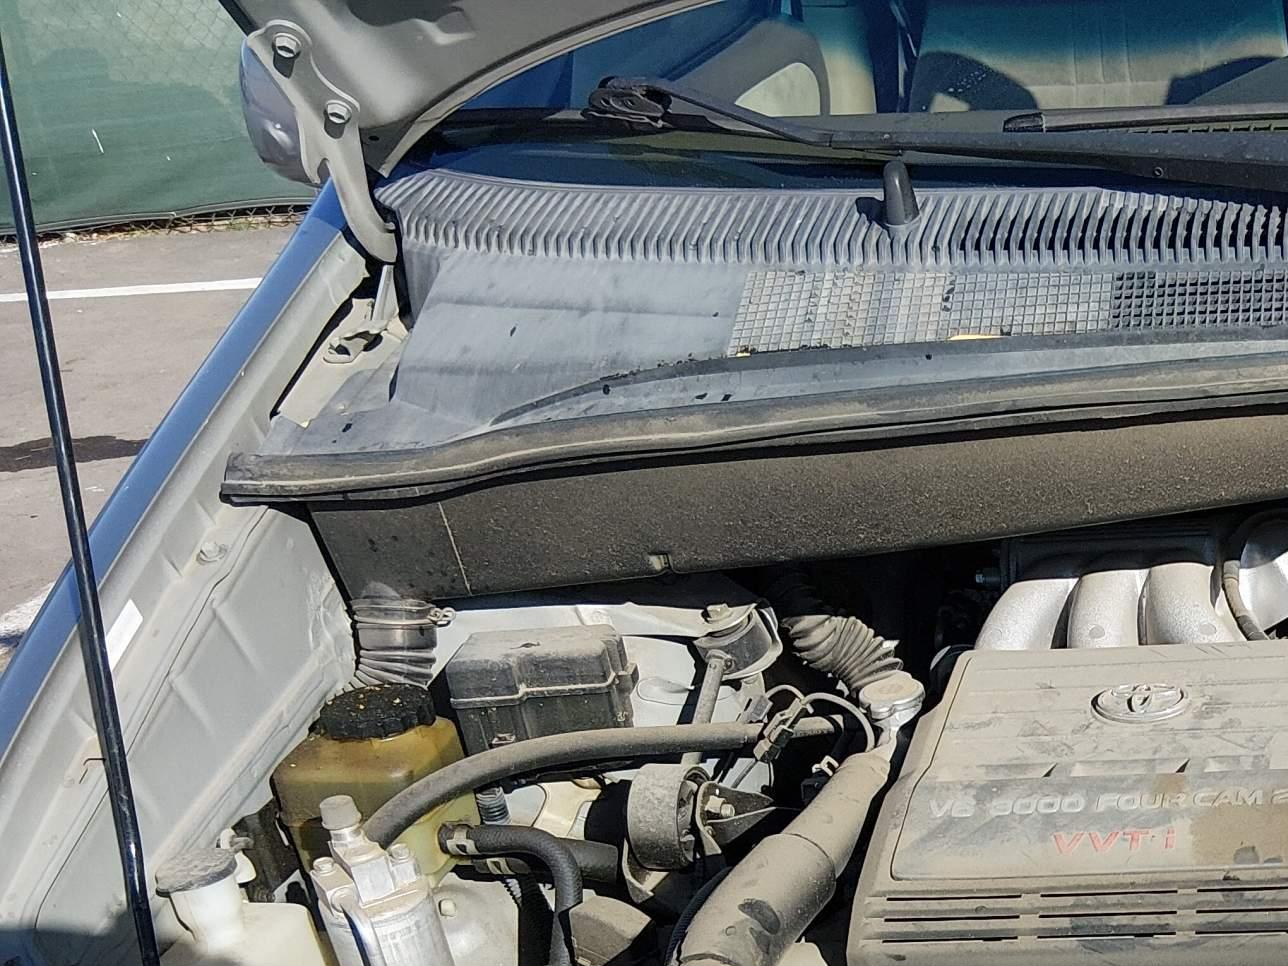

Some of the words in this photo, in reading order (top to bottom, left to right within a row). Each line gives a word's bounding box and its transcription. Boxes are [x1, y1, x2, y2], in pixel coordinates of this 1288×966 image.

[928, 799, 976, 817] V6
[989, 795, 1086, 816] 3000
[1096, 792, 1187, 812] FOUR
[1192, 787, 1264, 808] CAM
